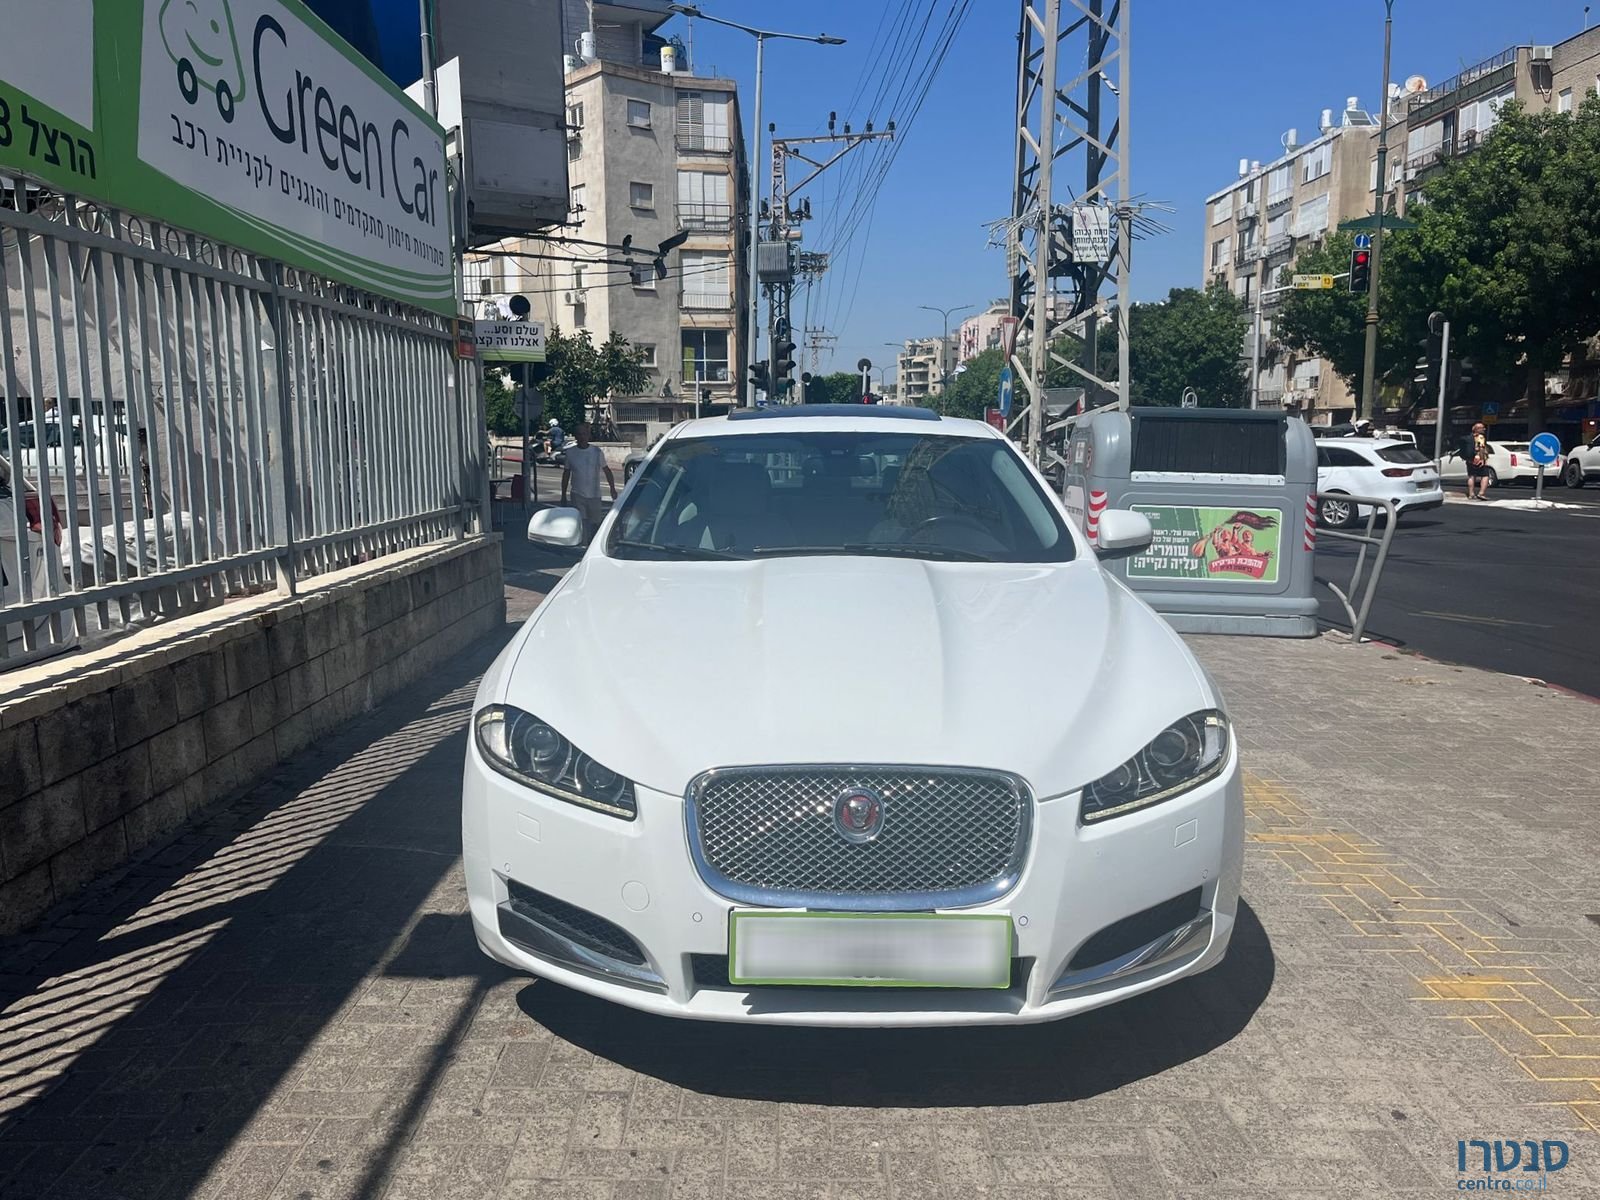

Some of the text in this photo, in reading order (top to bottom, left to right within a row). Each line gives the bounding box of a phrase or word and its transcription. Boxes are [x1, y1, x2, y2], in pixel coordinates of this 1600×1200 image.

[253, 14, 438, 227] Green Car
[21, 104, 96, 179] הרצל
[171, 114, 444, 267] פתרונות מימון מתקדמים והוגנים לקניית רכב
[484, 325, 512, 334] וסע...
[516, 325, 538, 335] שלם
[496, 337, 507, 345] זה
[511, 336, 539, 346] אצלנו
[1134, 556, 1199, 570] עליה נקייה!
